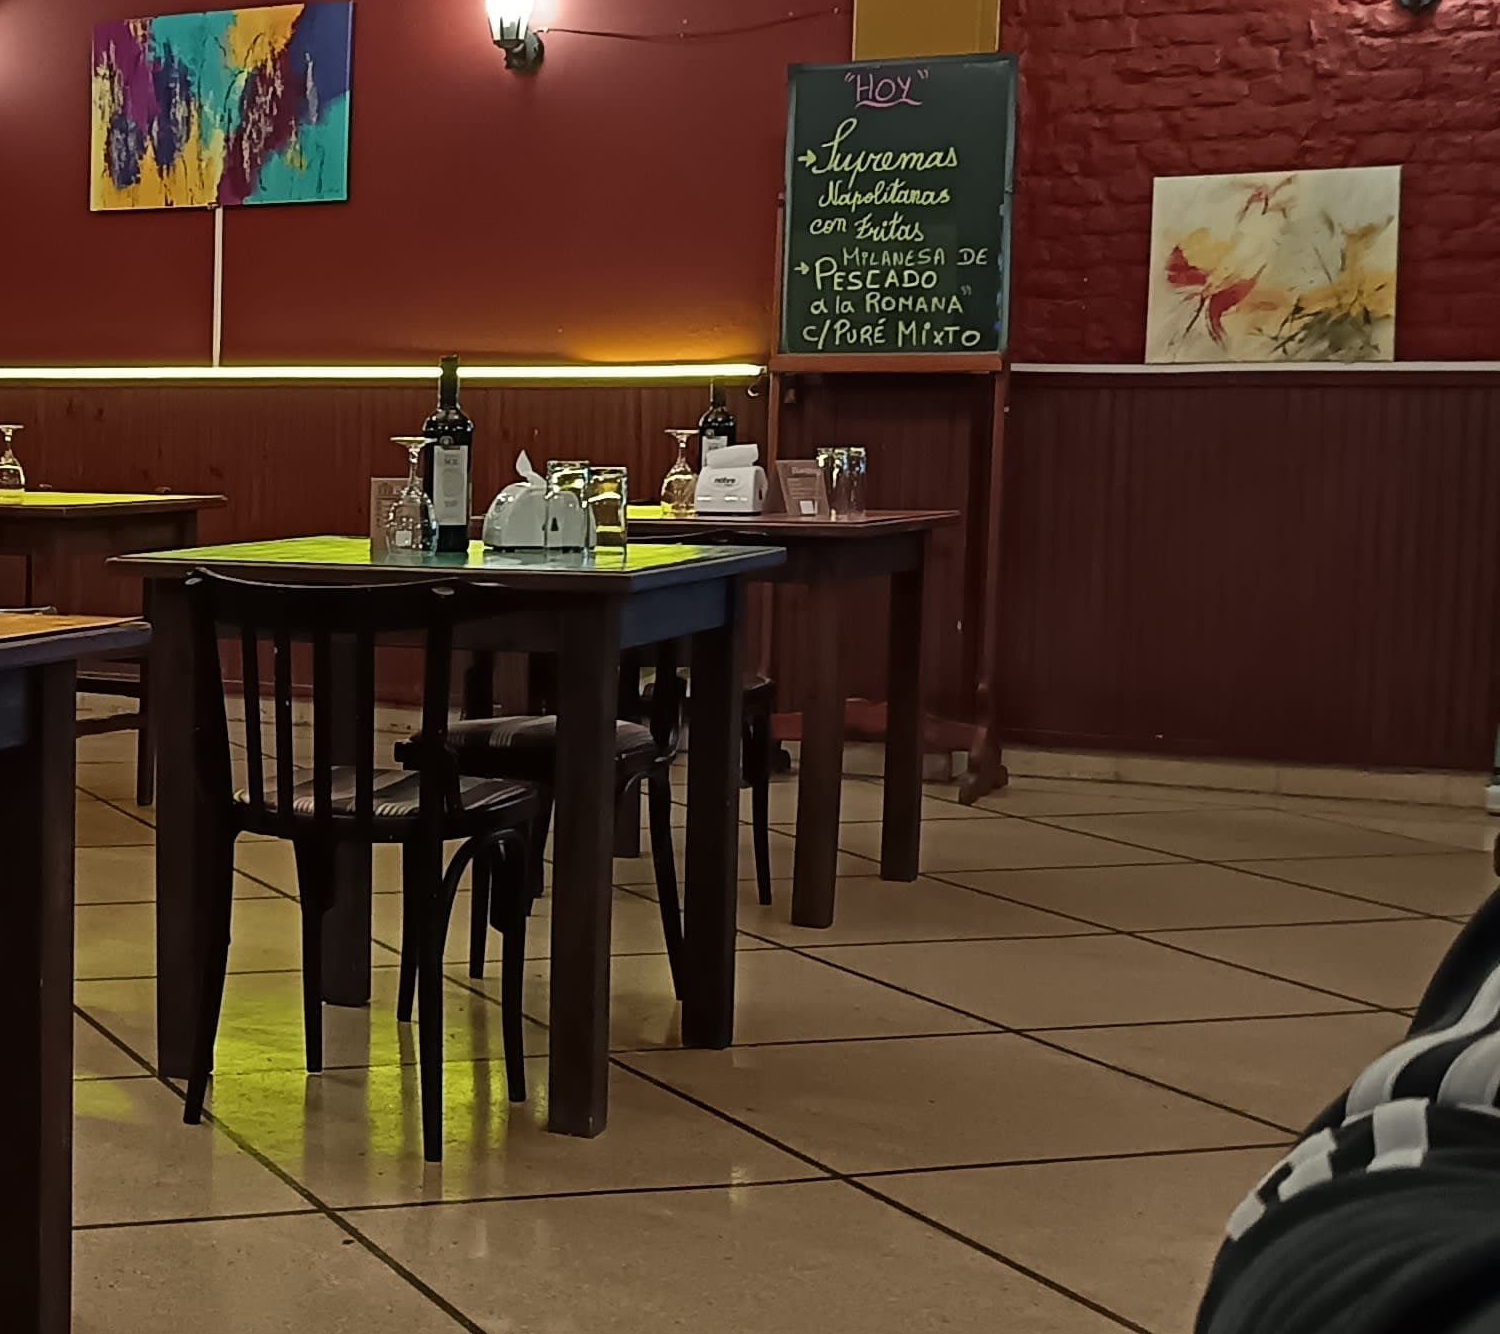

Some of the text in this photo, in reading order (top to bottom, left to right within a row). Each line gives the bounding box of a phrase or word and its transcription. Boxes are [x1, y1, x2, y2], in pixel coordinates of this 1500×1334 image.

[811, 117, 959, 189] Supremas
[818, 178, 951, 213] Napolitanas
[809, 211, 925, 243] con Fritas
[957, 247, 988, 266] DE
[815, 257, 938, 291] PESCADO
[810, 302, 828, 315] a
[835, 299, 855, 314] la
